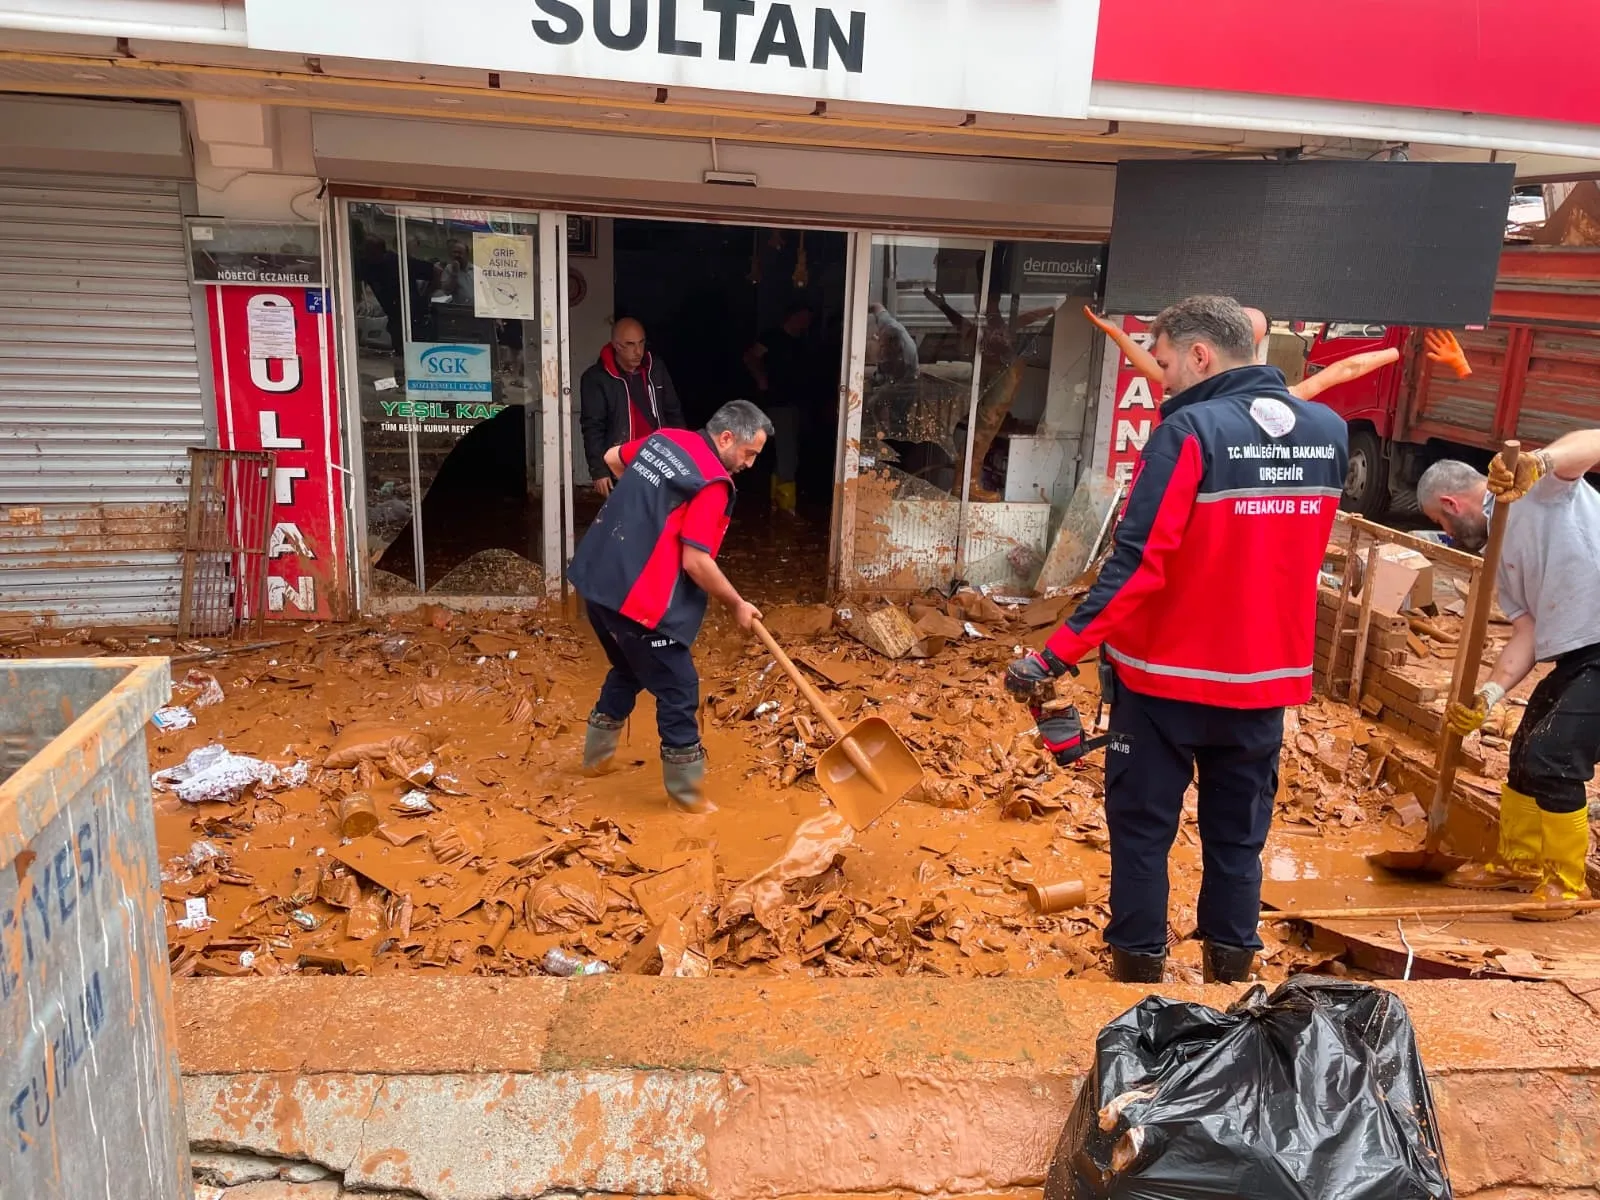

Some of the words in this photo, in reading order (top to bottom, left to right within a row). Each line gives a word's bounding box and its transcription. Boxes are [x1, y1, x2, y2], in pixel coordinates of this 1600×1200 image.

[531, 0, 866, 73] SULTAN
[493, 248, 515, 257] GRİP
[260, 272, 309, 282] ECZANELER
[428, 356, 470, 374] SGK
[381, 421, 397, 432] TÜM
[424, 424, 450, 434] KURUM
[1228, 446, 1243, 459] T.C.
[652, 458, 676, 479] AKUB
